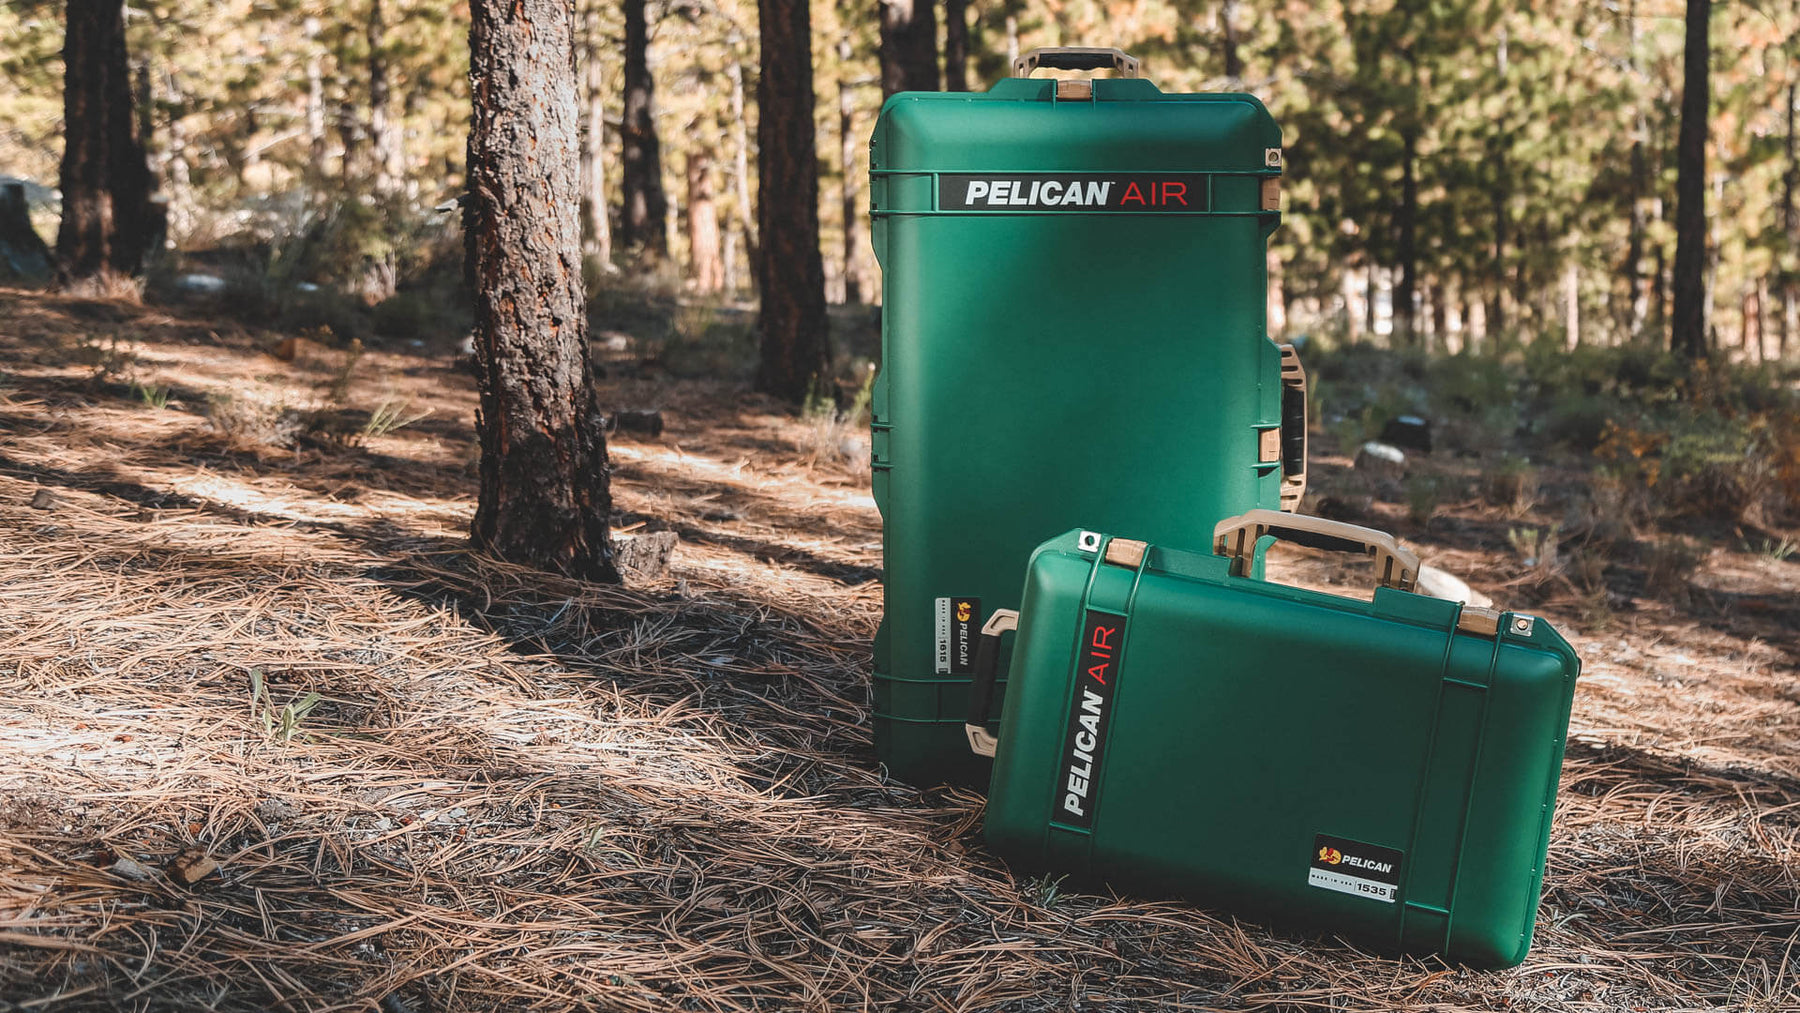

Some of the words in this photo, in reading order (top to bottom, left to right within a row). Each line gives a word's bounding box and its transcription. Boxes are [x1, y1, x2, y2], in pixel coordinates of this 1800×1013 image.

[965, 181, 1111, 206] PELICAN
[1119, 181, 1188, 206] AIR
[939, 639, 947, 663] 1615
[960, 623, 968, 666] PELICAN
[1064, 690, 1104, 817] PELICAN
[1088, 625, 1116, 686] AIR
[1341, 855, 1392, 873] PELICAN
[1357, 883, 1387, 896] 1535
